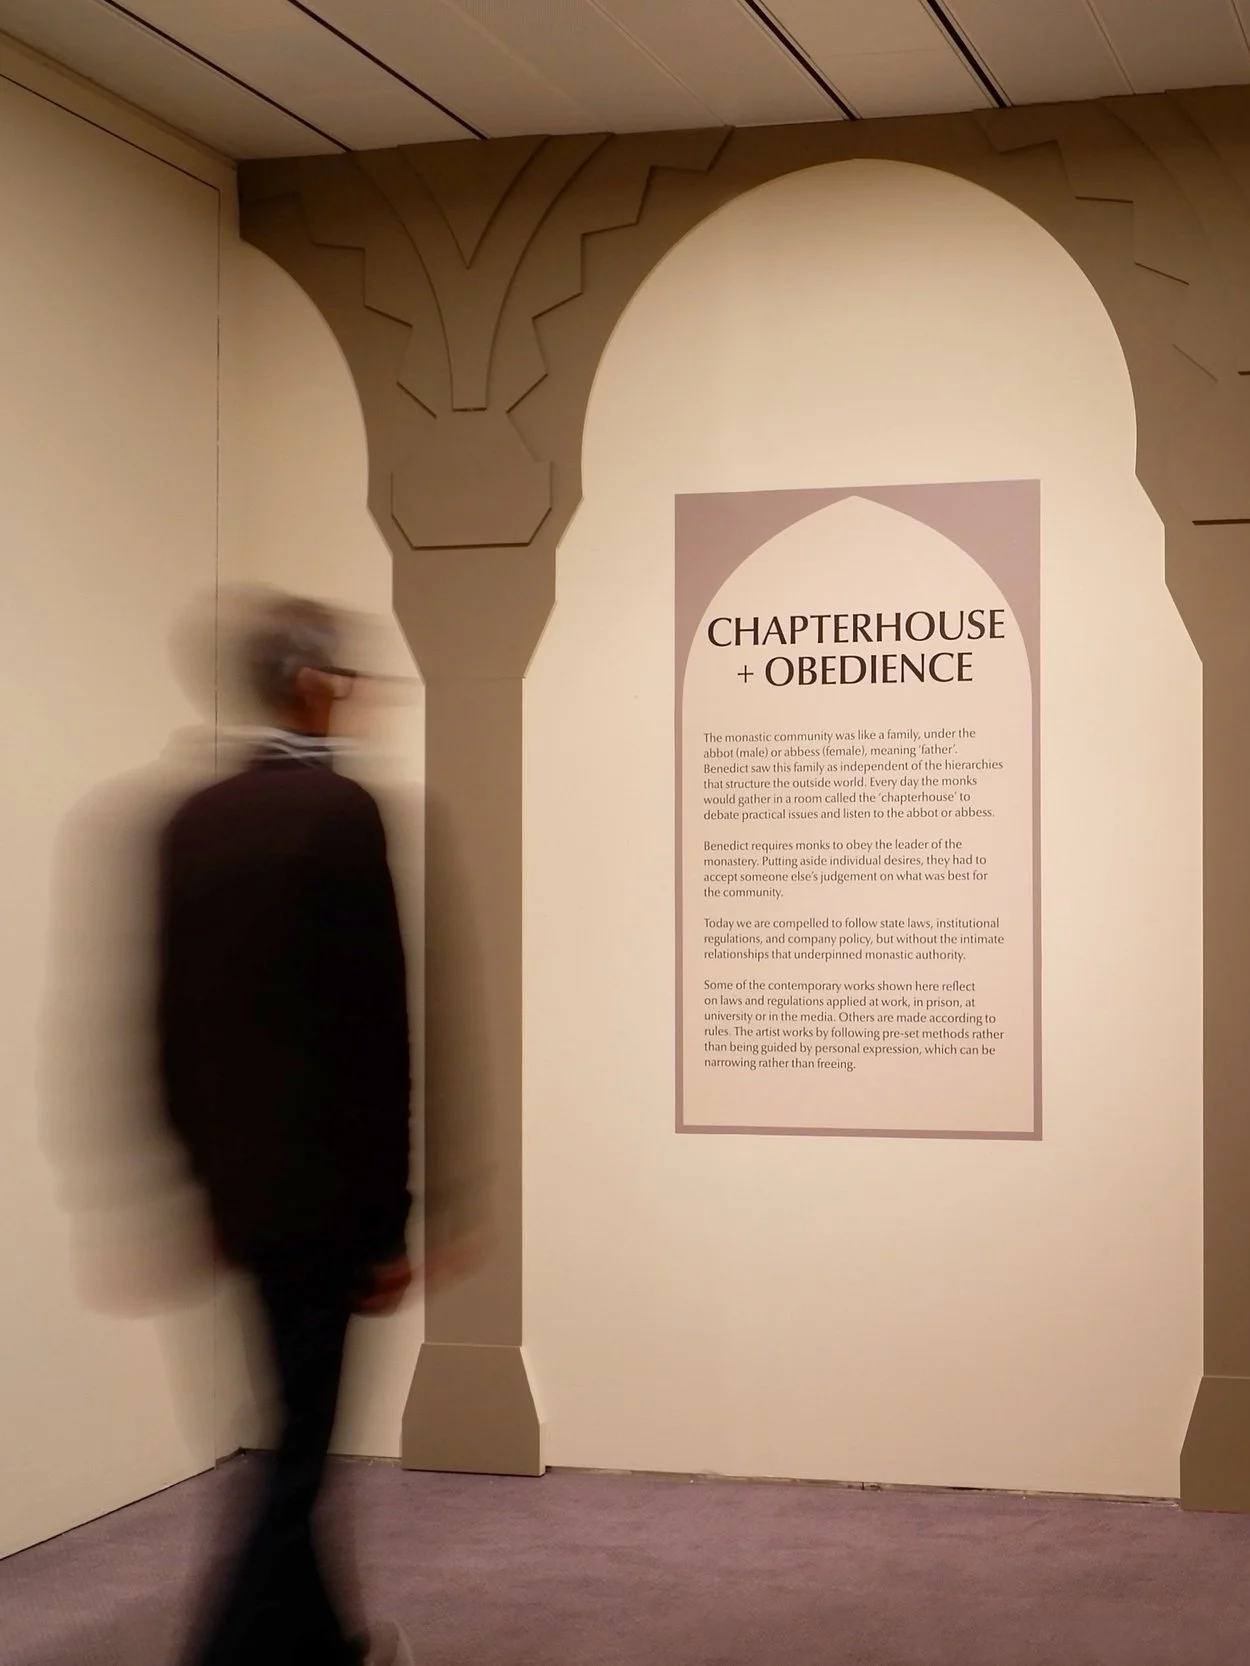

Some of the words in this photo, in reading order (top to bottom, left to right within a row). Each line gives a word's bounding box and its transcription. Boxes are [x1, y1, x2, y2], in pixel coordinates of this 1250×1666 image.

[707, 609, 1005, 647] CHAPTERHOUSE
[737, 665, 754, 683] +
[765, 652, 973, 687] OBEDIENCE
[703, 731, 722, 743] The
[725, 731, 771, 743] monastic
[773, 730, 833, 745] community
[835, 732, 855, 741] was
[857, 728, 876, 740] like
[878, 731, 884, 740] a
[887, 728, 920, 743] family,
[923, 727, 956, 739] under
[958, 727, 975, 739] the
[703, 746, 733, 759] abbot
[735, 746, 768, 759] (male)
[770, 749, 782, 758] or
[783, 745, 820, 757] abbess
[822, 744, 867, 758] (female),
[870, 744, 916, 759] meaning
[703, 762, 748, 774] Benedict
[751, 764, 770, 773] saw
[773, 761, 791, 773] this
[793, 760, 824, 776] family
[826, 763, 837, 772] as
[840, 759, 908, 775] independent
[910, 759, 922, 771] of
[924, 758, 942, 770] the
[945, 757, 1003, 770] hierarchies
[703, 778, 723, 790] that
[725, 779, 770, 789] structure
[772, 777, 789, 789] the
[792, 776, 830, 788] outside
[833, 775, 866, 788] world.
[870, 775, 897, 790] Every
[899, 775, 919, 790] day
[921, 774, 938, 786] the
[941, 774, 977, 786] monks
[703, 793, 735, 805] would
[737, 792, 771, 808] gather
[773, 793, 782, 804] in
[785, 795, 791, 804] a
[794, 795, 822, 804] room
[824, 791, 856, 803] called
[858, 791, 875, 803] the
[959, 792, 970, 802] to
[703, 808, 739, 820] debate
[742, 807, 785, 823] practical
[788, 808, 818, 819] issues
[820, 807, 840, 819] and
[843, 806, 870, 818] listen
[873, 808, 884, 818] to
[886, 806, 904, 818] the
[906, 806, 938, 818] abbot
[940, 809, 952, 817] or
[954, 805, 994, 817] abbess.
[704, 839, 748, 851] Benedict
[751, 840, 793, 854] requires
[795, 839, 830, 851] monks
[832, 840, 843, 850] to
[845, 838, 872, 853] obey
[875, 838, 892, 850] the
[895, 838, 929, 850] leader
[930, 838, 943, 849] of
[944, 837, 962, 849] the
[703, 857, 759, 870] monastery.
[762, 854, 798, 870] Putting
[799, 854, 827, 866] aside
[829, 854, 881, 866] individual
[883, 854, 923, 867] desires,
[926, 853, 950, 869] they
[952, 853, 972, 865] had
[975, 855, 986, 865] to
[703, 872, 737, 886] accept
[740, 873, 788, 882] someone
[820, 870, 876, 885] judgement
[879, 873, 893, 882] on
[896, 870, 921, 881] what
[924, 873, 945, 881] was
[947, 869, 969, 881] best
[972, 869, 988, 881] for
[703, 885, 720, 897] the
[722, 886, 783, 900] community.
[704, 916, 734, 931] Today
[736, 920, 751, 928] we
[754, 920, 770, 928] are
[772, 916, 828, 931] compelled
[831, 918, 842, 928] to
[845, 916, 877, 928] follow
[880, 918, 904, 928] state
[907, 916, 933, 930] laws,
[936, 916, 999, 928] institutional
[704, 932, 762, 947] regulations,
[765, 932, 785, 944] and
[787, 936, 836, 947] company
[839, 932, 873, 947] policy,
[876, 932, 893, 944] but
[896, 932, 937, 944] without
[940, 932, 957, 944] the
[960, 933, 1004, 944] intimate
[704, 947, 769, 962] relationships
[771, 947, 791, 959] that
[794, 948, 862, 963] underpinned
[865, 948, 913, 960] monastic
[915, 948, 965, 963] authority.
[704, 978, 733, 990] Some
[735, 978, 747, 990] of
[748, 979, 765, 990] the
[767, 981, 841, 994] contemporary
[843, 979, 875, 991] works
[877, 979, 912, 991] shown
[915, 980, 939, 992] here
[942, 980, 975, 992] reflect
[704, 997, 717, 1006] on
[720, 994, 742, 1006] laws
[744, 994, 764, 1006] and
[767, 994, 824, 1010] regulations
[826, 995, 866, 1010] applied
[868, 997, 878, 1007] at
[880, 995, 910, 1009] work,
[913, 996, 923, 1007] in
[926, 996, 962, 1011] prison,
[965, 998, 975, 1008] at
[704, 1010, 752, 1025] university
[755, 1013, 766, 1021] or
[768, 1011, 778, 1022] in
[780, 1010, 797, 1022] the
[800, 1010, 835, 1022] media.
[838, 1010, 874, 1022] Others
[877, 1014, 893, 1023] are
[896, 1011, 926, 1023] made
[929, 1011, 982, 1027] according
[985, 1014, 996, 1024] to
[734, 1025, 753, 1037] The
[755, 1026, 779, 1037] artist
[782, 1025, 813, 1038] works
[815, 1026, 828, 1041] by
[831, 1026, 880, 1042] following
[882, 1029, 919, 1042] pre-set
[922, 1027, 969, 1039] methods
[972, 1028, 1004, 1040] rather
[704, 1040, 727, 1052] than
[729, 1040, 759, 1056] being
[760, 1041, 796, 1056] guided
[799, 1041, 812, 1056] by
[815, 1041, 859, 1057] personal
[862, 1043, 921, 1057] expression,
[924, 1043, 956, 1055] which
[959, 1046, 978, 1055] can
[981, 1043, 995, 1055] be
[704, 1056, 756, 1071] narrowing
[758, 1056, 789, 1068] rather
[791, 1056, 814, 1068] than
[817, 1057, 856, 1072] freeing.
